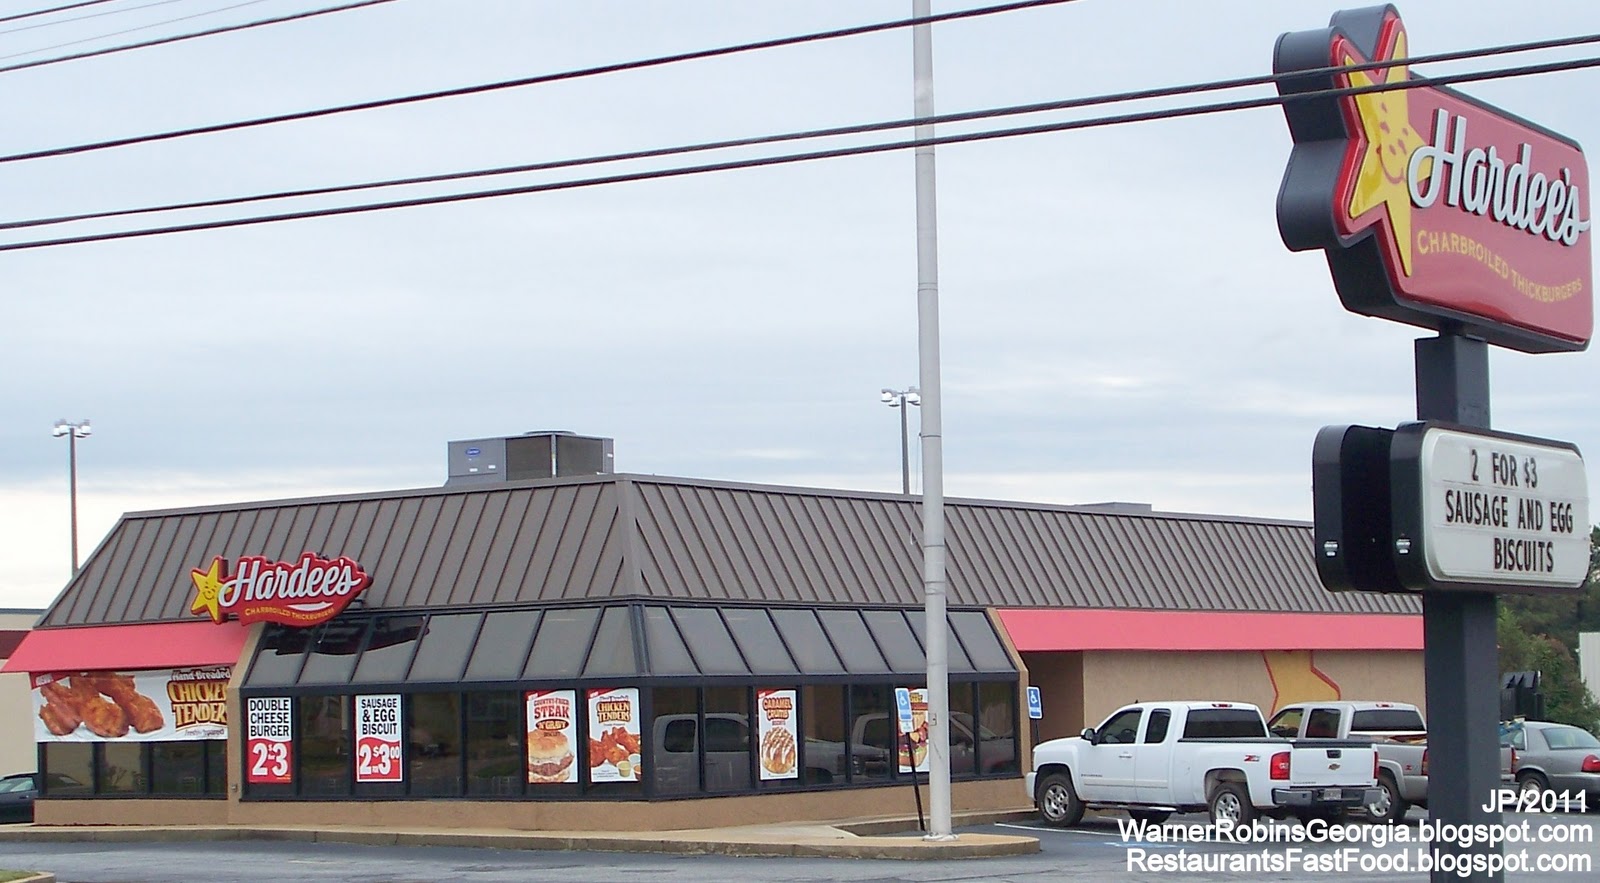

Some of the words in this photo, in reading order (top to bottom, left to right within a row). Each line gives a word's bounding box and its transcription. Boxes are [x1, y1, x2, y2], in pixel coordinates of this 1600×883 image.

[1408, 108, 1591, 246] Hardee's
[1417, 229, 1509, 280] CHARBROILED
[1511, 268, 1583, 303] THICKBURGERS
[1471, 449, 1479, 481] 2
[1492, 452, 1518, 487] FOR
[1524, 457, 1538, 489] $3
[1445, 489, 1509, 528] SAUSAGE
[1518, 498, 1543, 531] AND
[1550, 501, 1573, 534] EGG
[1494, 537, 1554, 573] BISCUITS
[218, 557, 362, 608] Hardee's
[250, 699, 289, 711] DOUBLE
[361, 698, 397, 709] SAUSAGE
[597, 702, 630, 712] CHICKEN
[763, 697, 792, 710] CARAMEL
[173, 702, 228, 726] TENDER
[250, 712, 289, 724] CHEESE
[362, 709, 371, 722] &
[373, 709, 396, 722] EGG
[534, 705, 570, 719] STEAK
[598, 711, 631, 722] TENDERS
[250, 725, 289, 737] BURGER
[362, 723, 397, 735] BISCUIT
[252, 742, 268, 776] 2
[359, 743, 372, 775] 2
